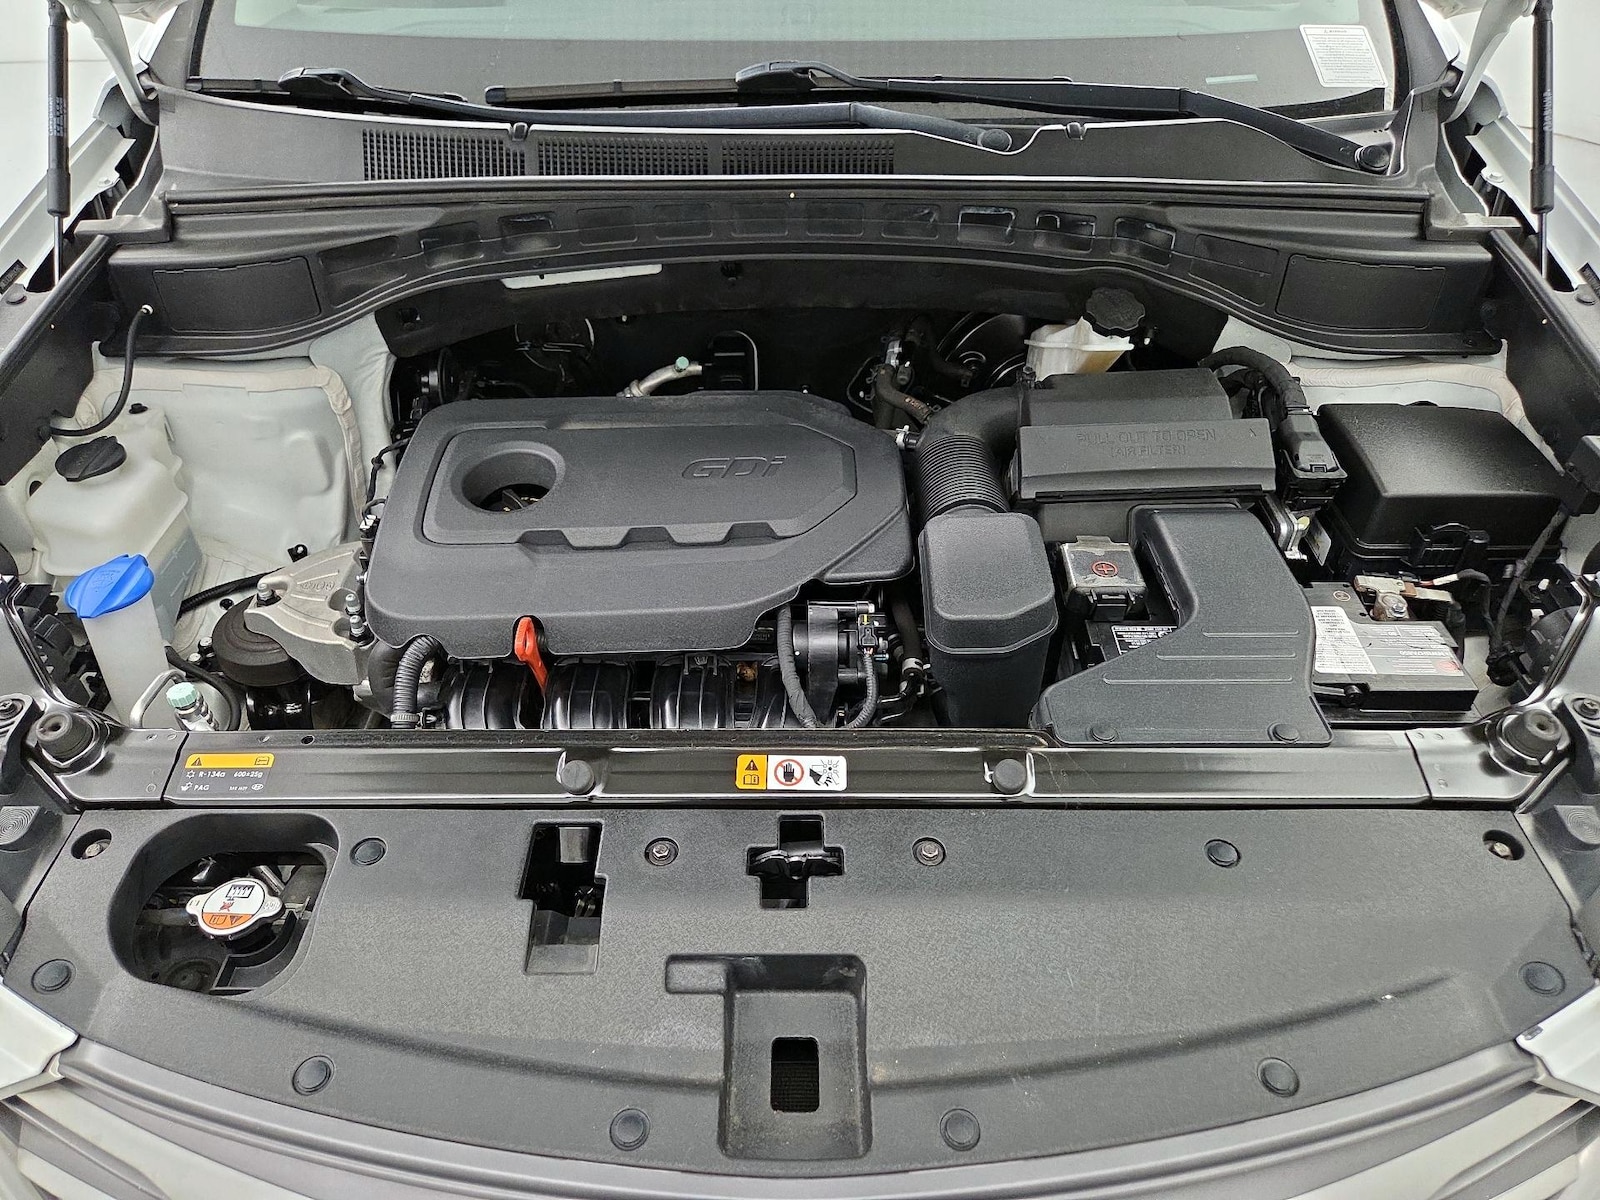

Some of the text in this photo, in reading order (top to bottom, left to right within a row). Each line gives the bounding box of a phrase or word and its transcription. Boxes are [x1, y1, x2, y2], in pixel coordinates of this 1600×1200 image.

[1076, 429, 1216, 445] PULL OUT TO OPEN
[682, 455, 787, 478] GDi
